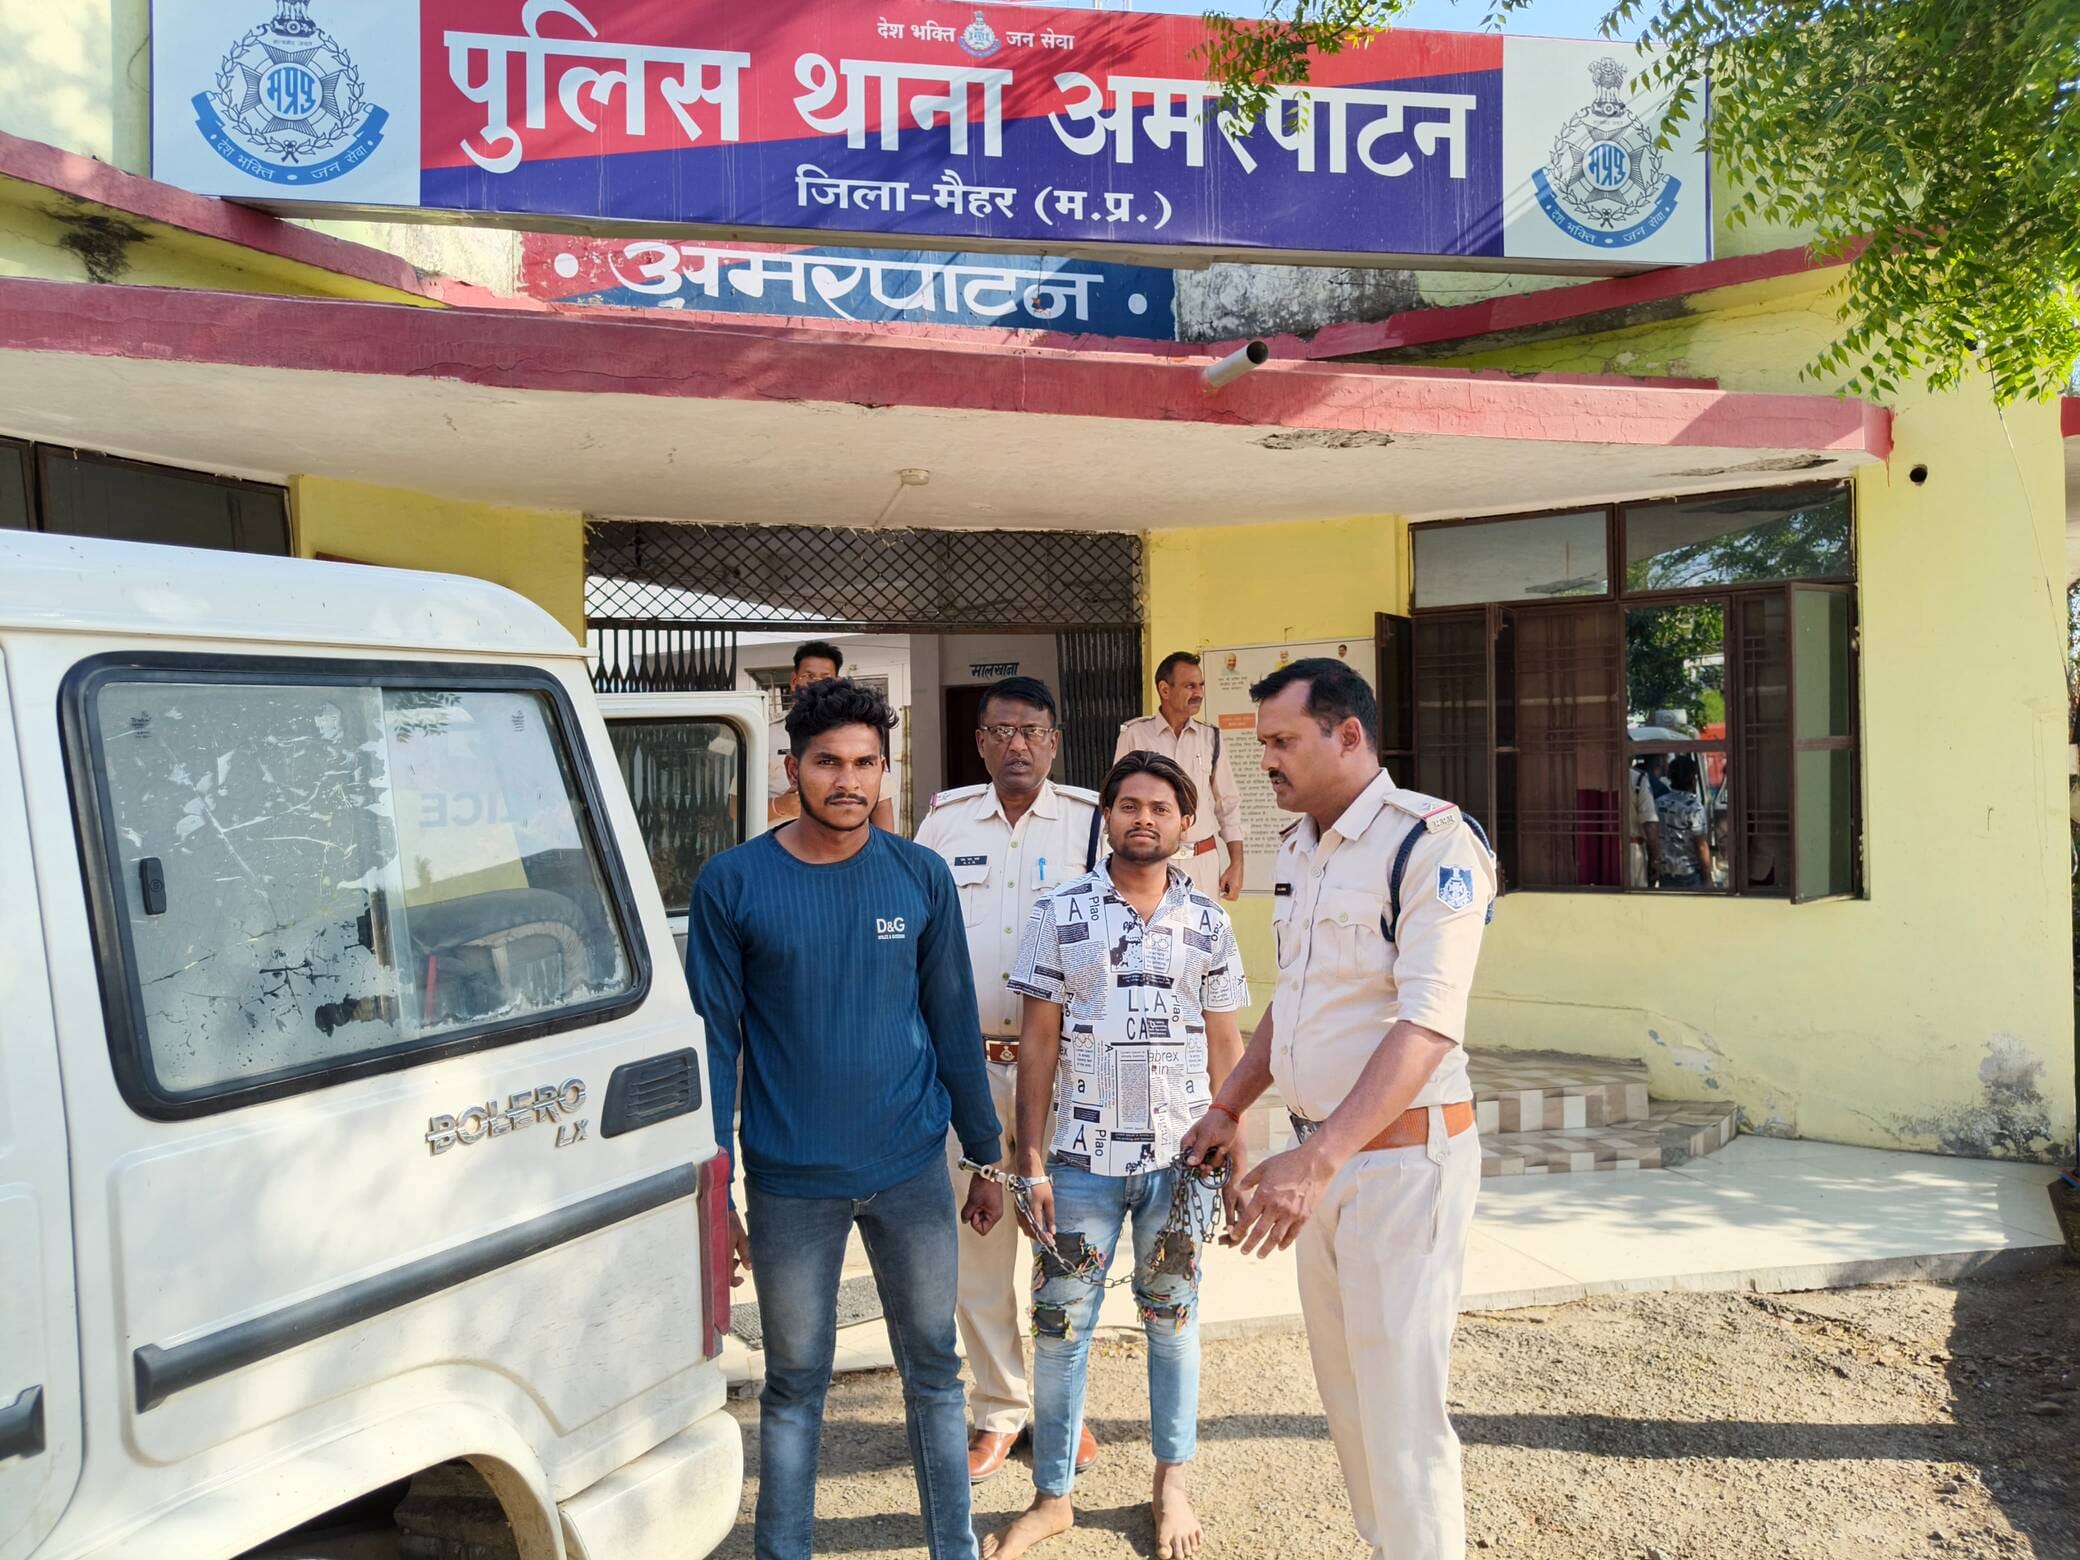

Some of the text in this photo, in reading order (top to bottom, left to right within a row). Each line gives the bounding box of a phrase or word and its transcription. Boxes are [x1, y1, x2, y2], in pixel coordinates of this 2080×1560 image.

[877, 17, 1075, 50] देश भक्ति जन सेवा
[443, 0, 1477, 179] पुलिस थाना अमरपाटन
[237, 155, 276, 180] भक्ति
[311, 161, 342, 179] जन
[344, 144, 368, 164] सेवा
[795, 163, 1172, 230] जिला-मैहर (म.प्र.)
[607, 241, 1104, 321] अमरपाटन
[969, 662, 1020, 680] मालखाना
[1068, 896, 1083, 922] A
[1199, 909, 1212, 932] A
[876, 917, 905, 933] D&G
[425, 1077, 587, 1156] BOLERO
[555, 1118, 589, 1148] LX
[1072, 1123, 1087, 1152] A
